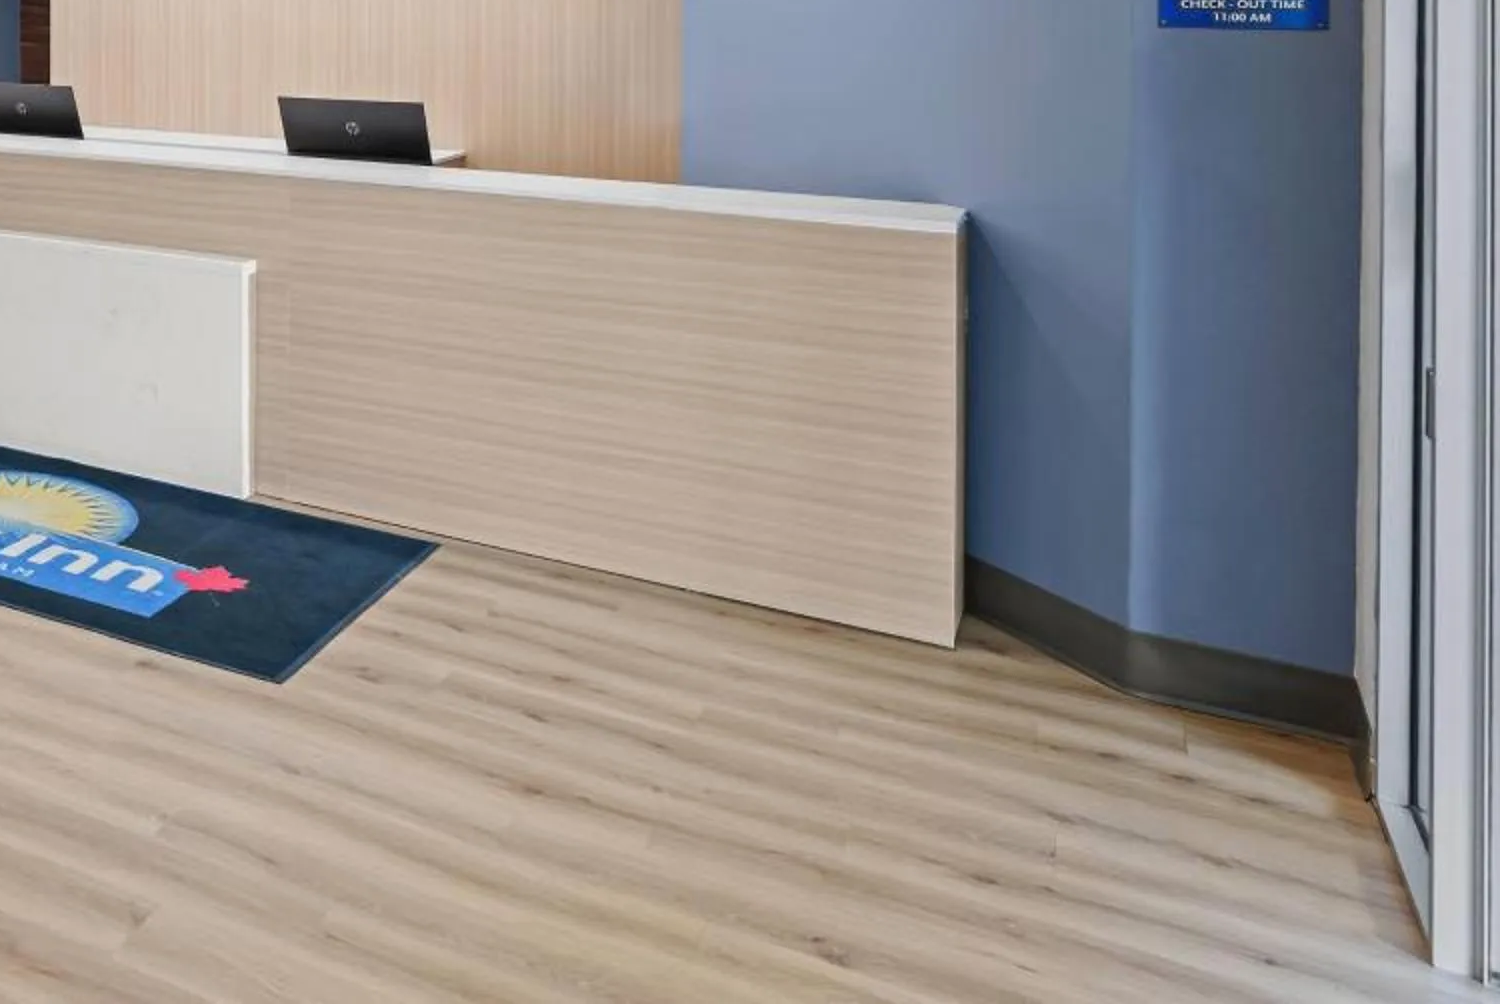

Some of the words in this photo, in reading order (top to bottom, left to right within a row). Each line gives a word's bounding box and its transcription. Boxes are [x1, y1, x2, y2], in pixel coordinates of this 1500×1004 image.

[1180, 0, 1226, 9] CHECK
[1236, 0, 1268, 9] OUT
[1270, 0, 1306, 9] TIME
[1213, 11, 1248, 22] 11:00
[1249, 12, 1273, 23] AM
